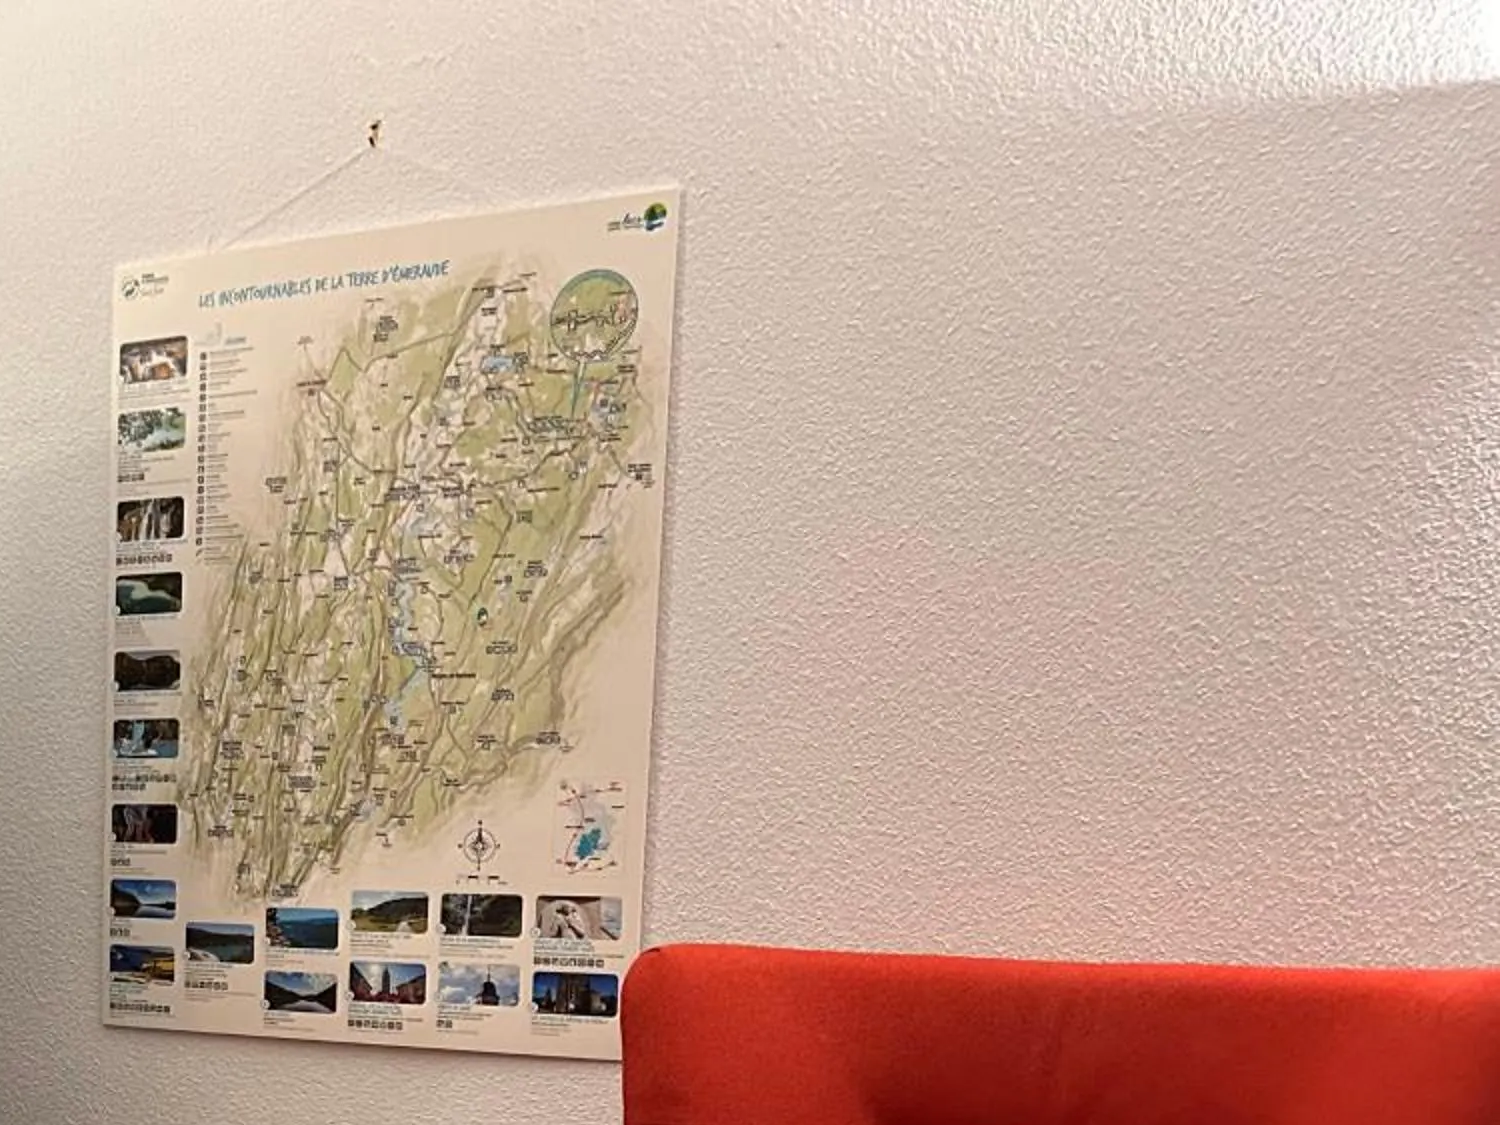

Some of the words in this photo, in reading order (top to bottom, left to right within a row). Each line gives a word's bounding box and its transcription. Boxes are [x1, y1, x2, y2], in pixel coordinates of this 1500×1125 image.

[198, 291, 215, 308] LES
[218, 277, 312, 306] INCONTOURNABLES
[315, 276, 330, 291] DE
[331, 275, 344, 290] LA
[347, 270, 379, 288] TERRE
